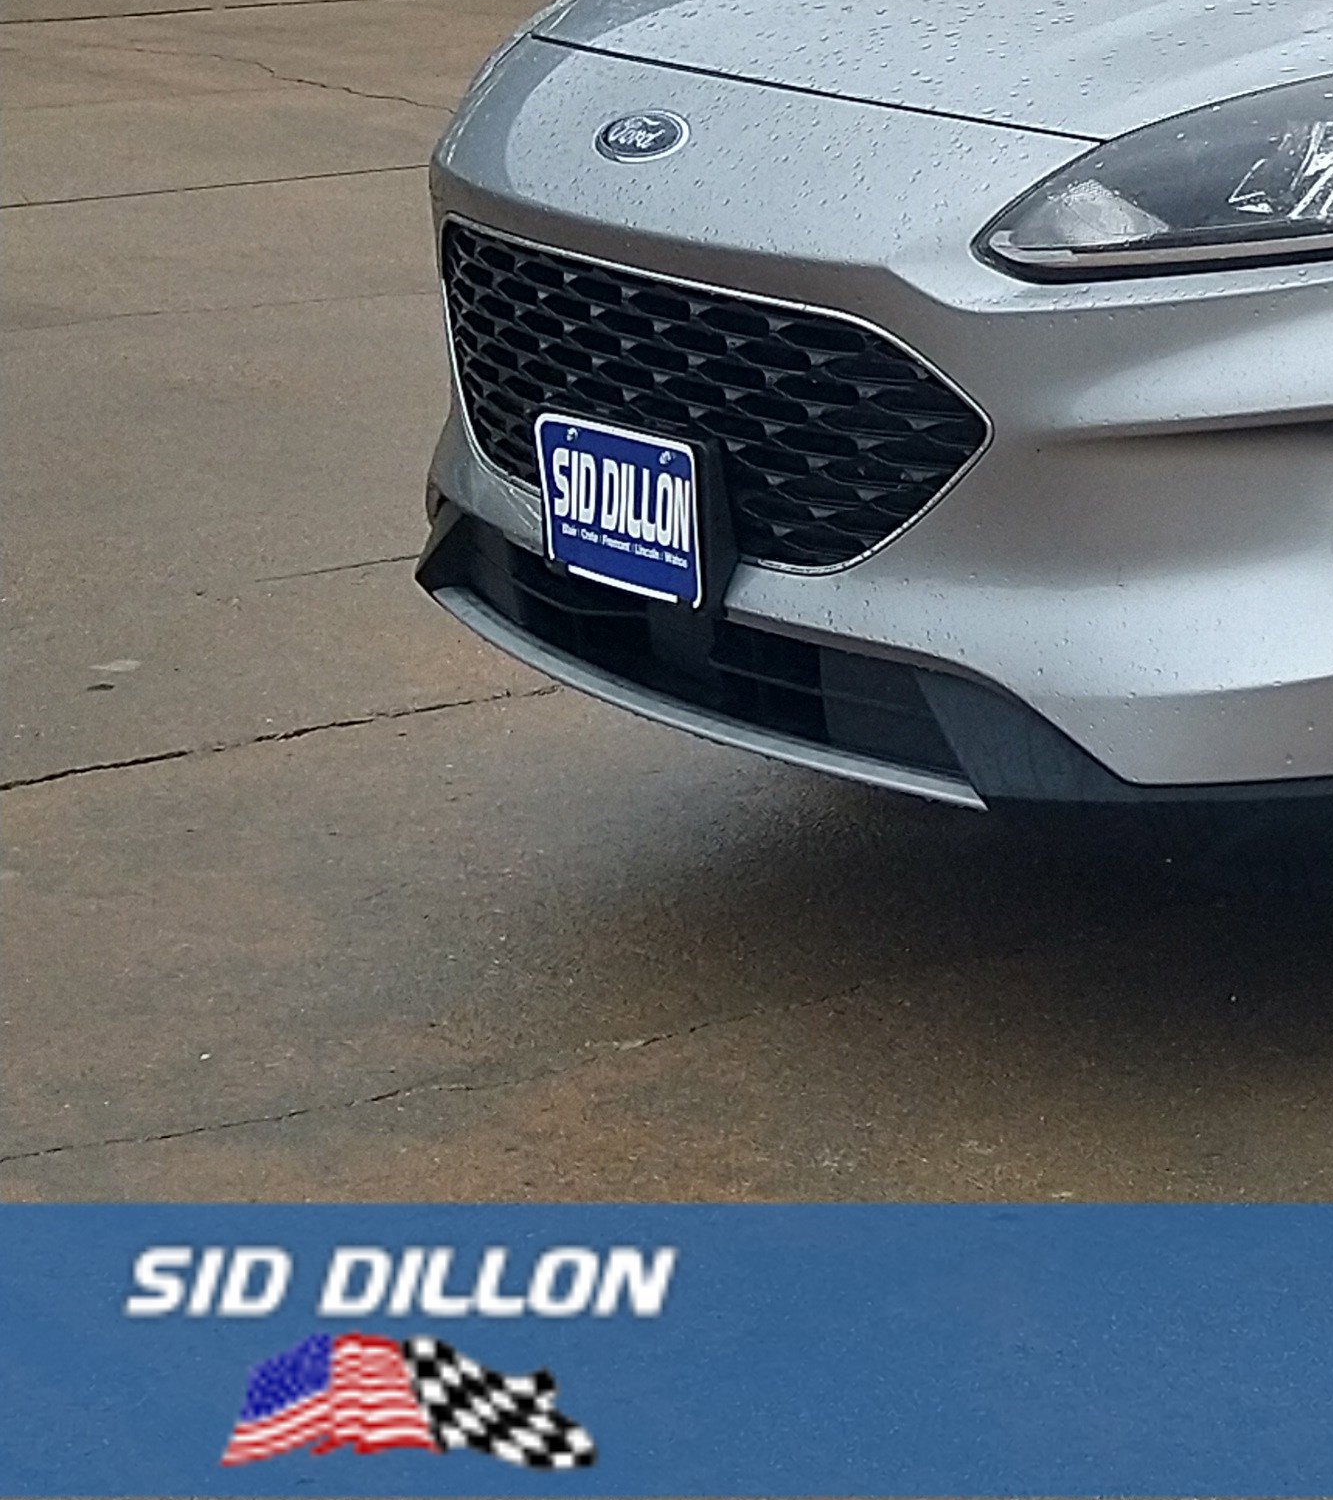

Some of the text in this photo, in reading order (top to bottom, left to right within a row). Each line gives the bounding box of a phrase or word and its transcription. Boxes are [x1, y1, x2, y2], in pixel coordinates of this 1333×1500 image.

[606, 115, 667, 150] Ford
[552, 447, 690, 553] SID DILLON
